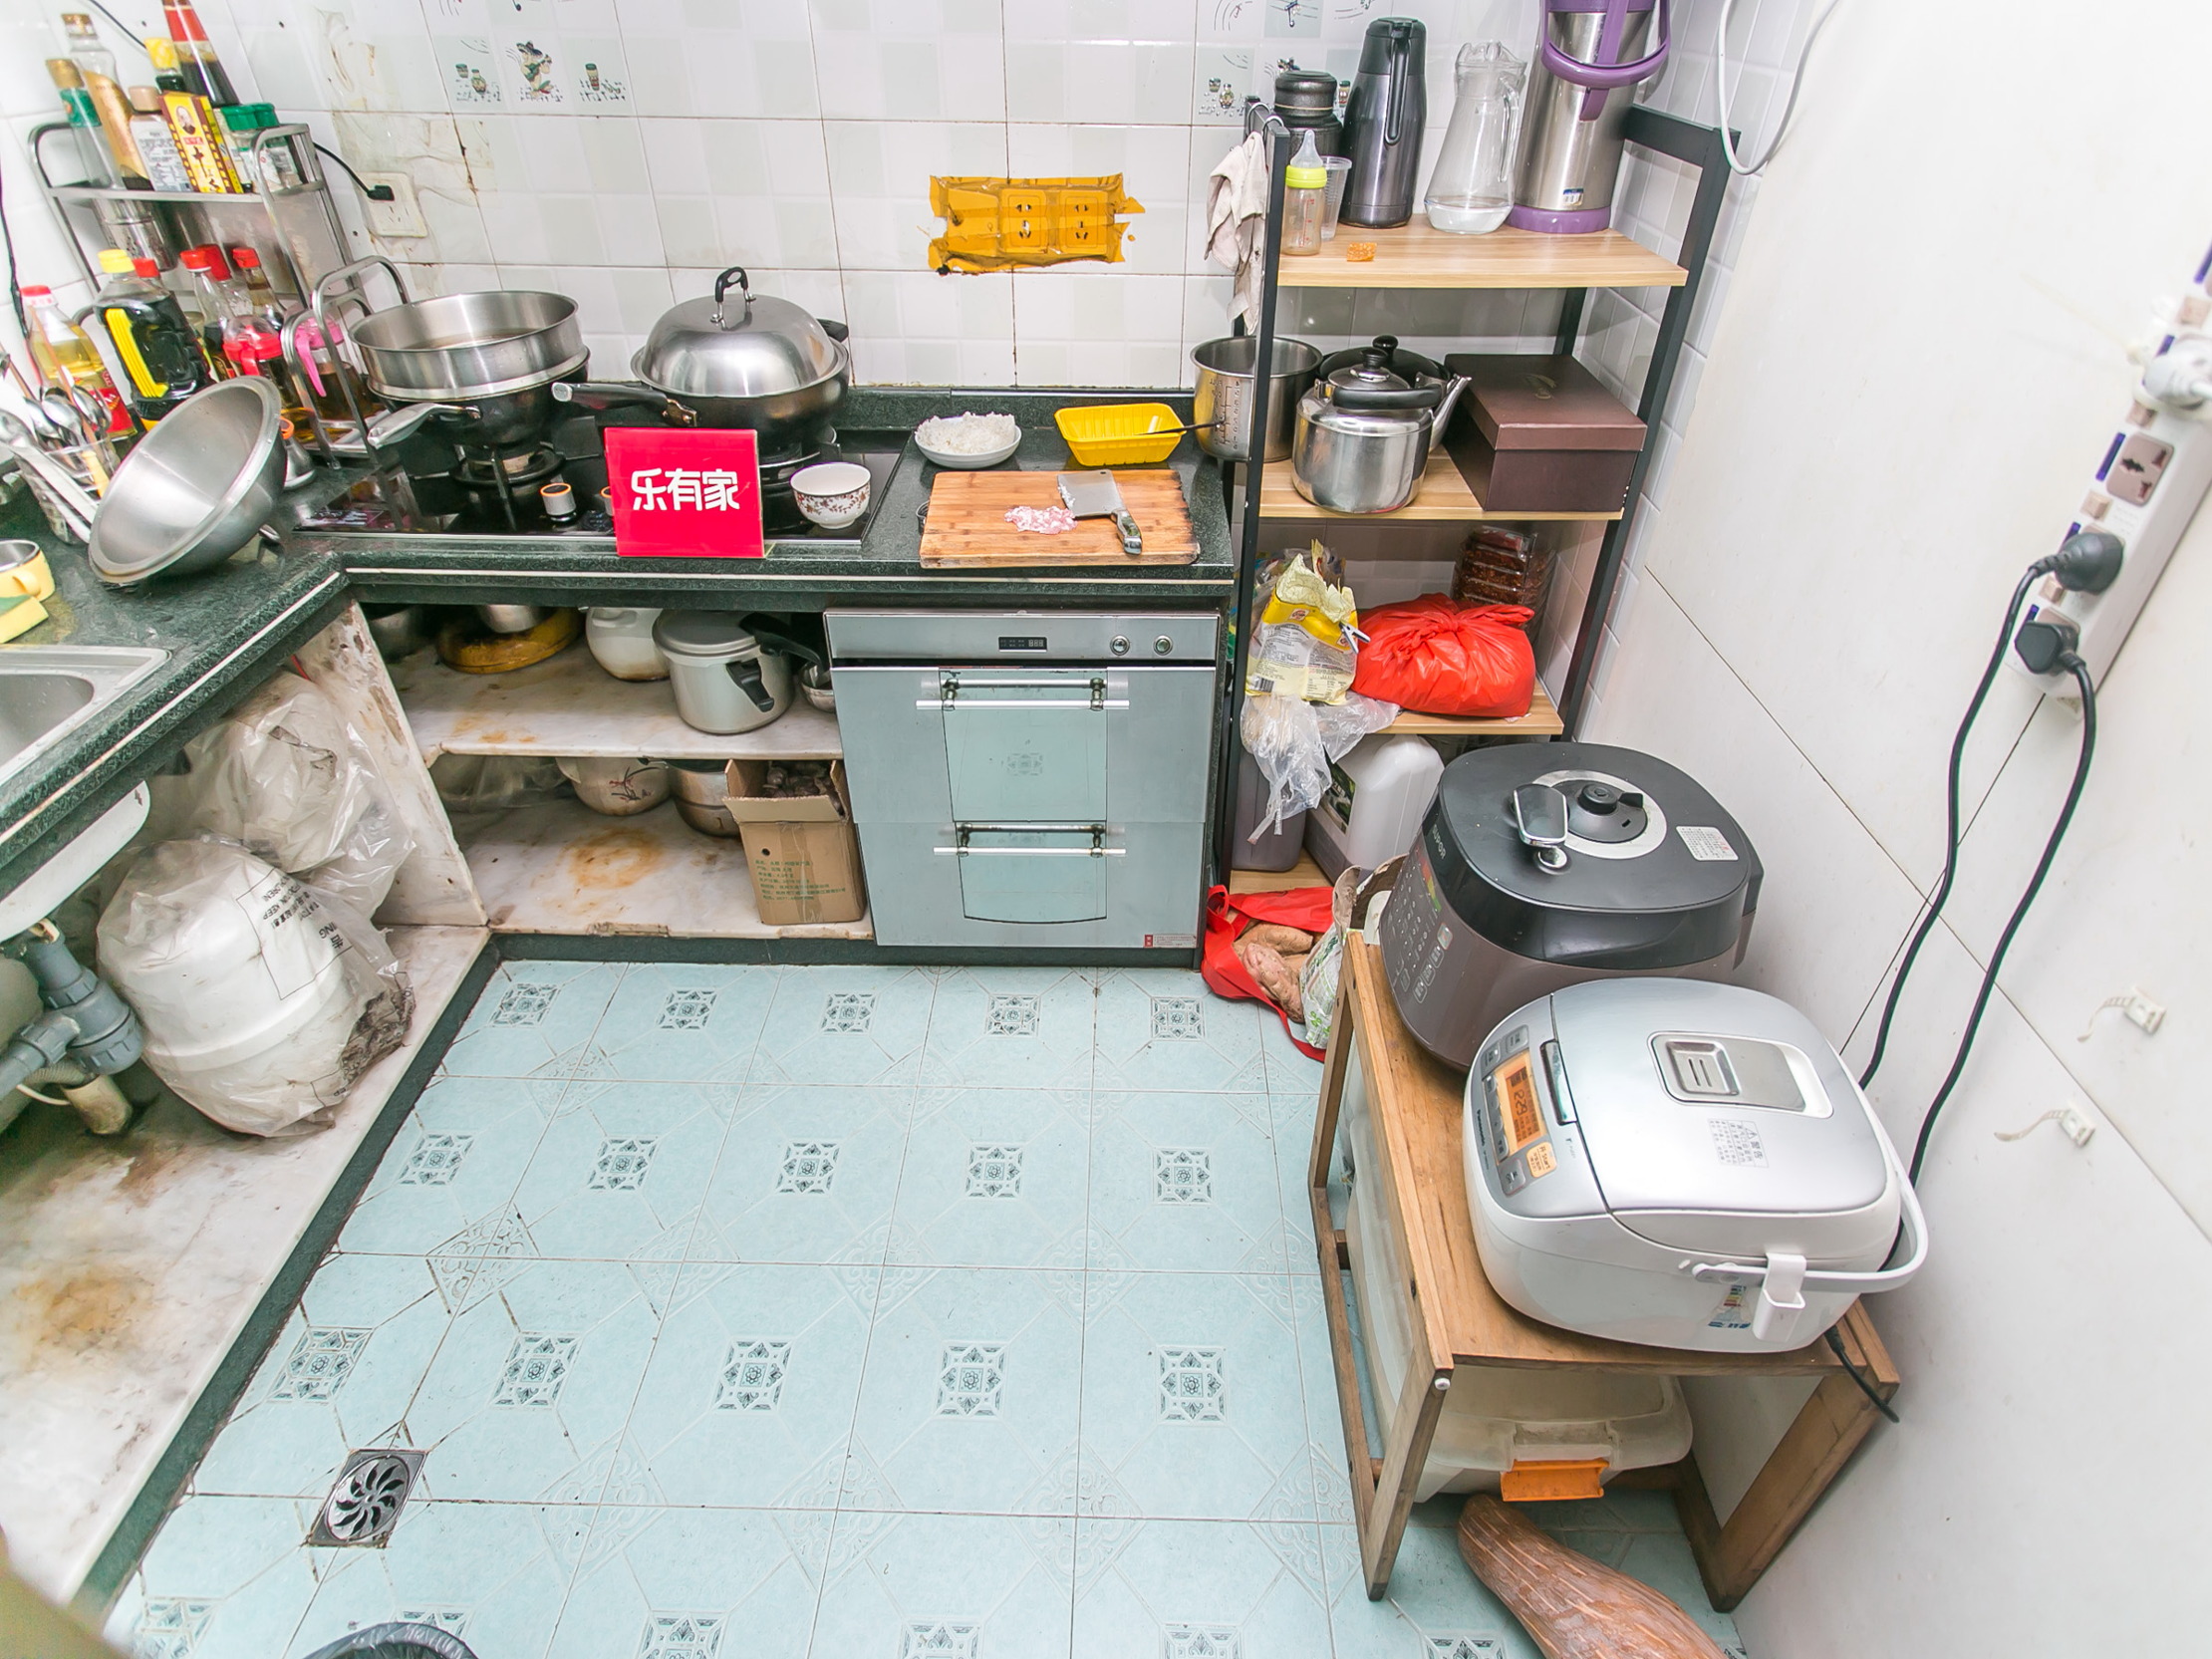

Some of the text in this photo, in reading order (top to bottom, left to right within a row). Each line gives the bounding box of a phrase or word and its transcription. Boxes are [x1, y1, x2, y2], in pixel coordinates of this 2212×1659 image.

[631, 467, 740, 511] 乐有家
[1433, 824, 1447, 859] SUPOR
[261, 904, 281, 921] KEEP
